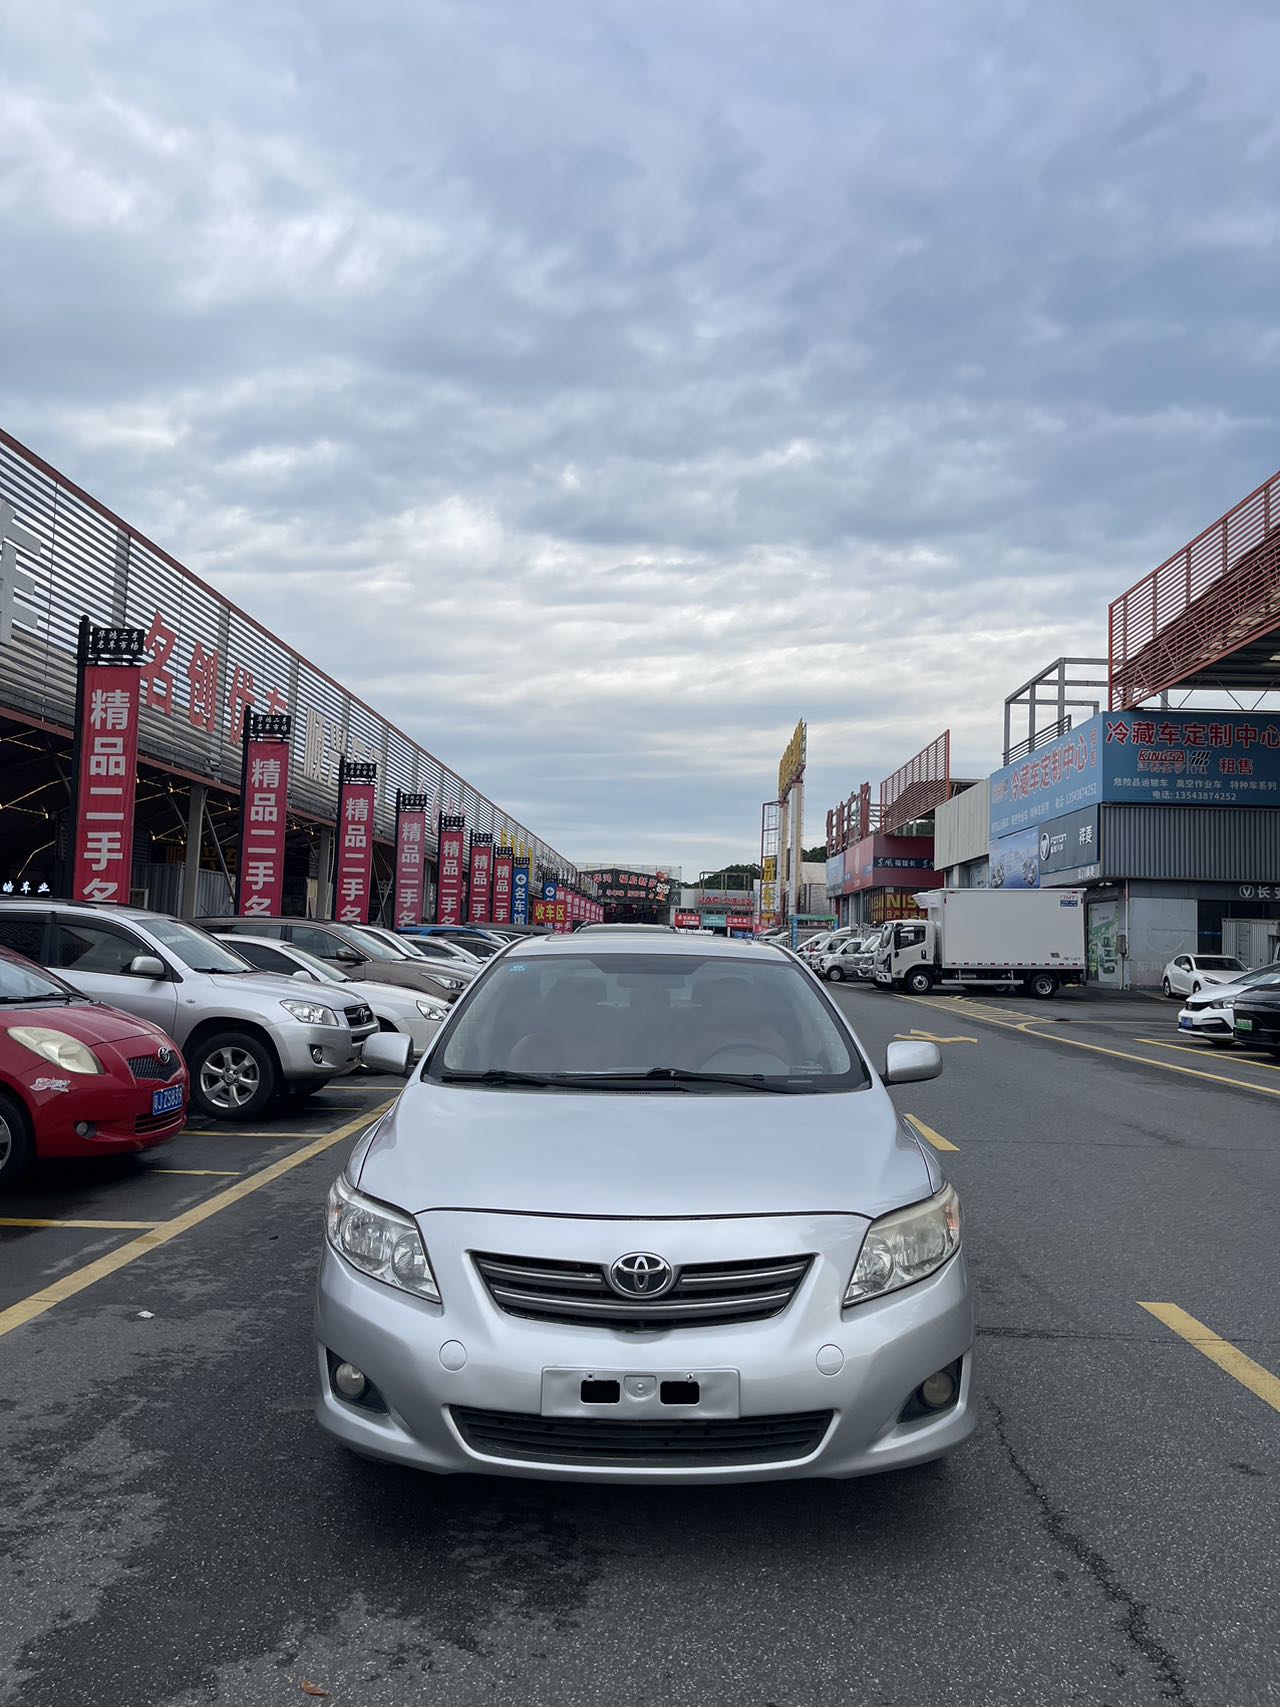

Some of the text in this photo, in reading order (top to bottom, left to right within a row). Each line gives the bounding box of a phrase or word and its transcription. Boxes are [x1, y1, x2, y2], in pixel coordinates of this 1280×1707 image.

[1106, 720, 1280, 748] 冷藏车定制中心
[1219, 758, 1254, 775] 租售
[1113, 777, 1277, 791] 危险品运输车 高空作业车 特种车系列
[1152, 790, 1237, 801] 电话: 13543874252
[535, 904, 565, 919] 收车区
